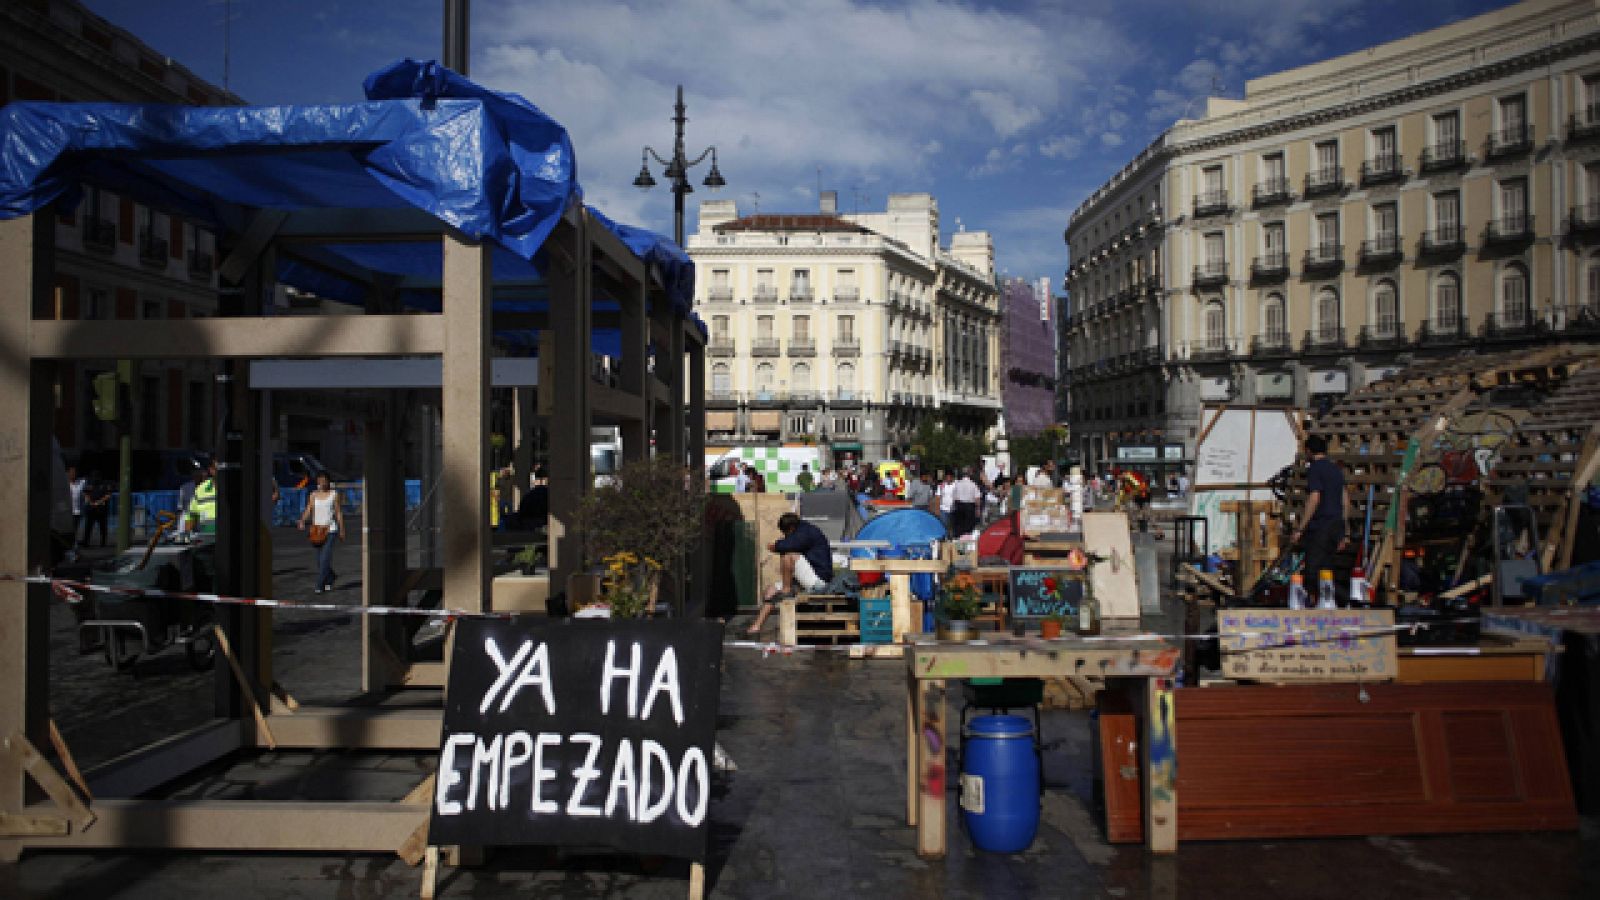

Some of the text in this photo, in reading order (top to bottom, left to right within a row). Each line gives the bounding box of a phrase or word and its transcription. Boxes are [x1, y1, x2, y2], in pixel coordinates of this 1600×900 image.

[479, 636, 684, 726] YA HA
[437, 731, 709, 828] EMPEZADO
